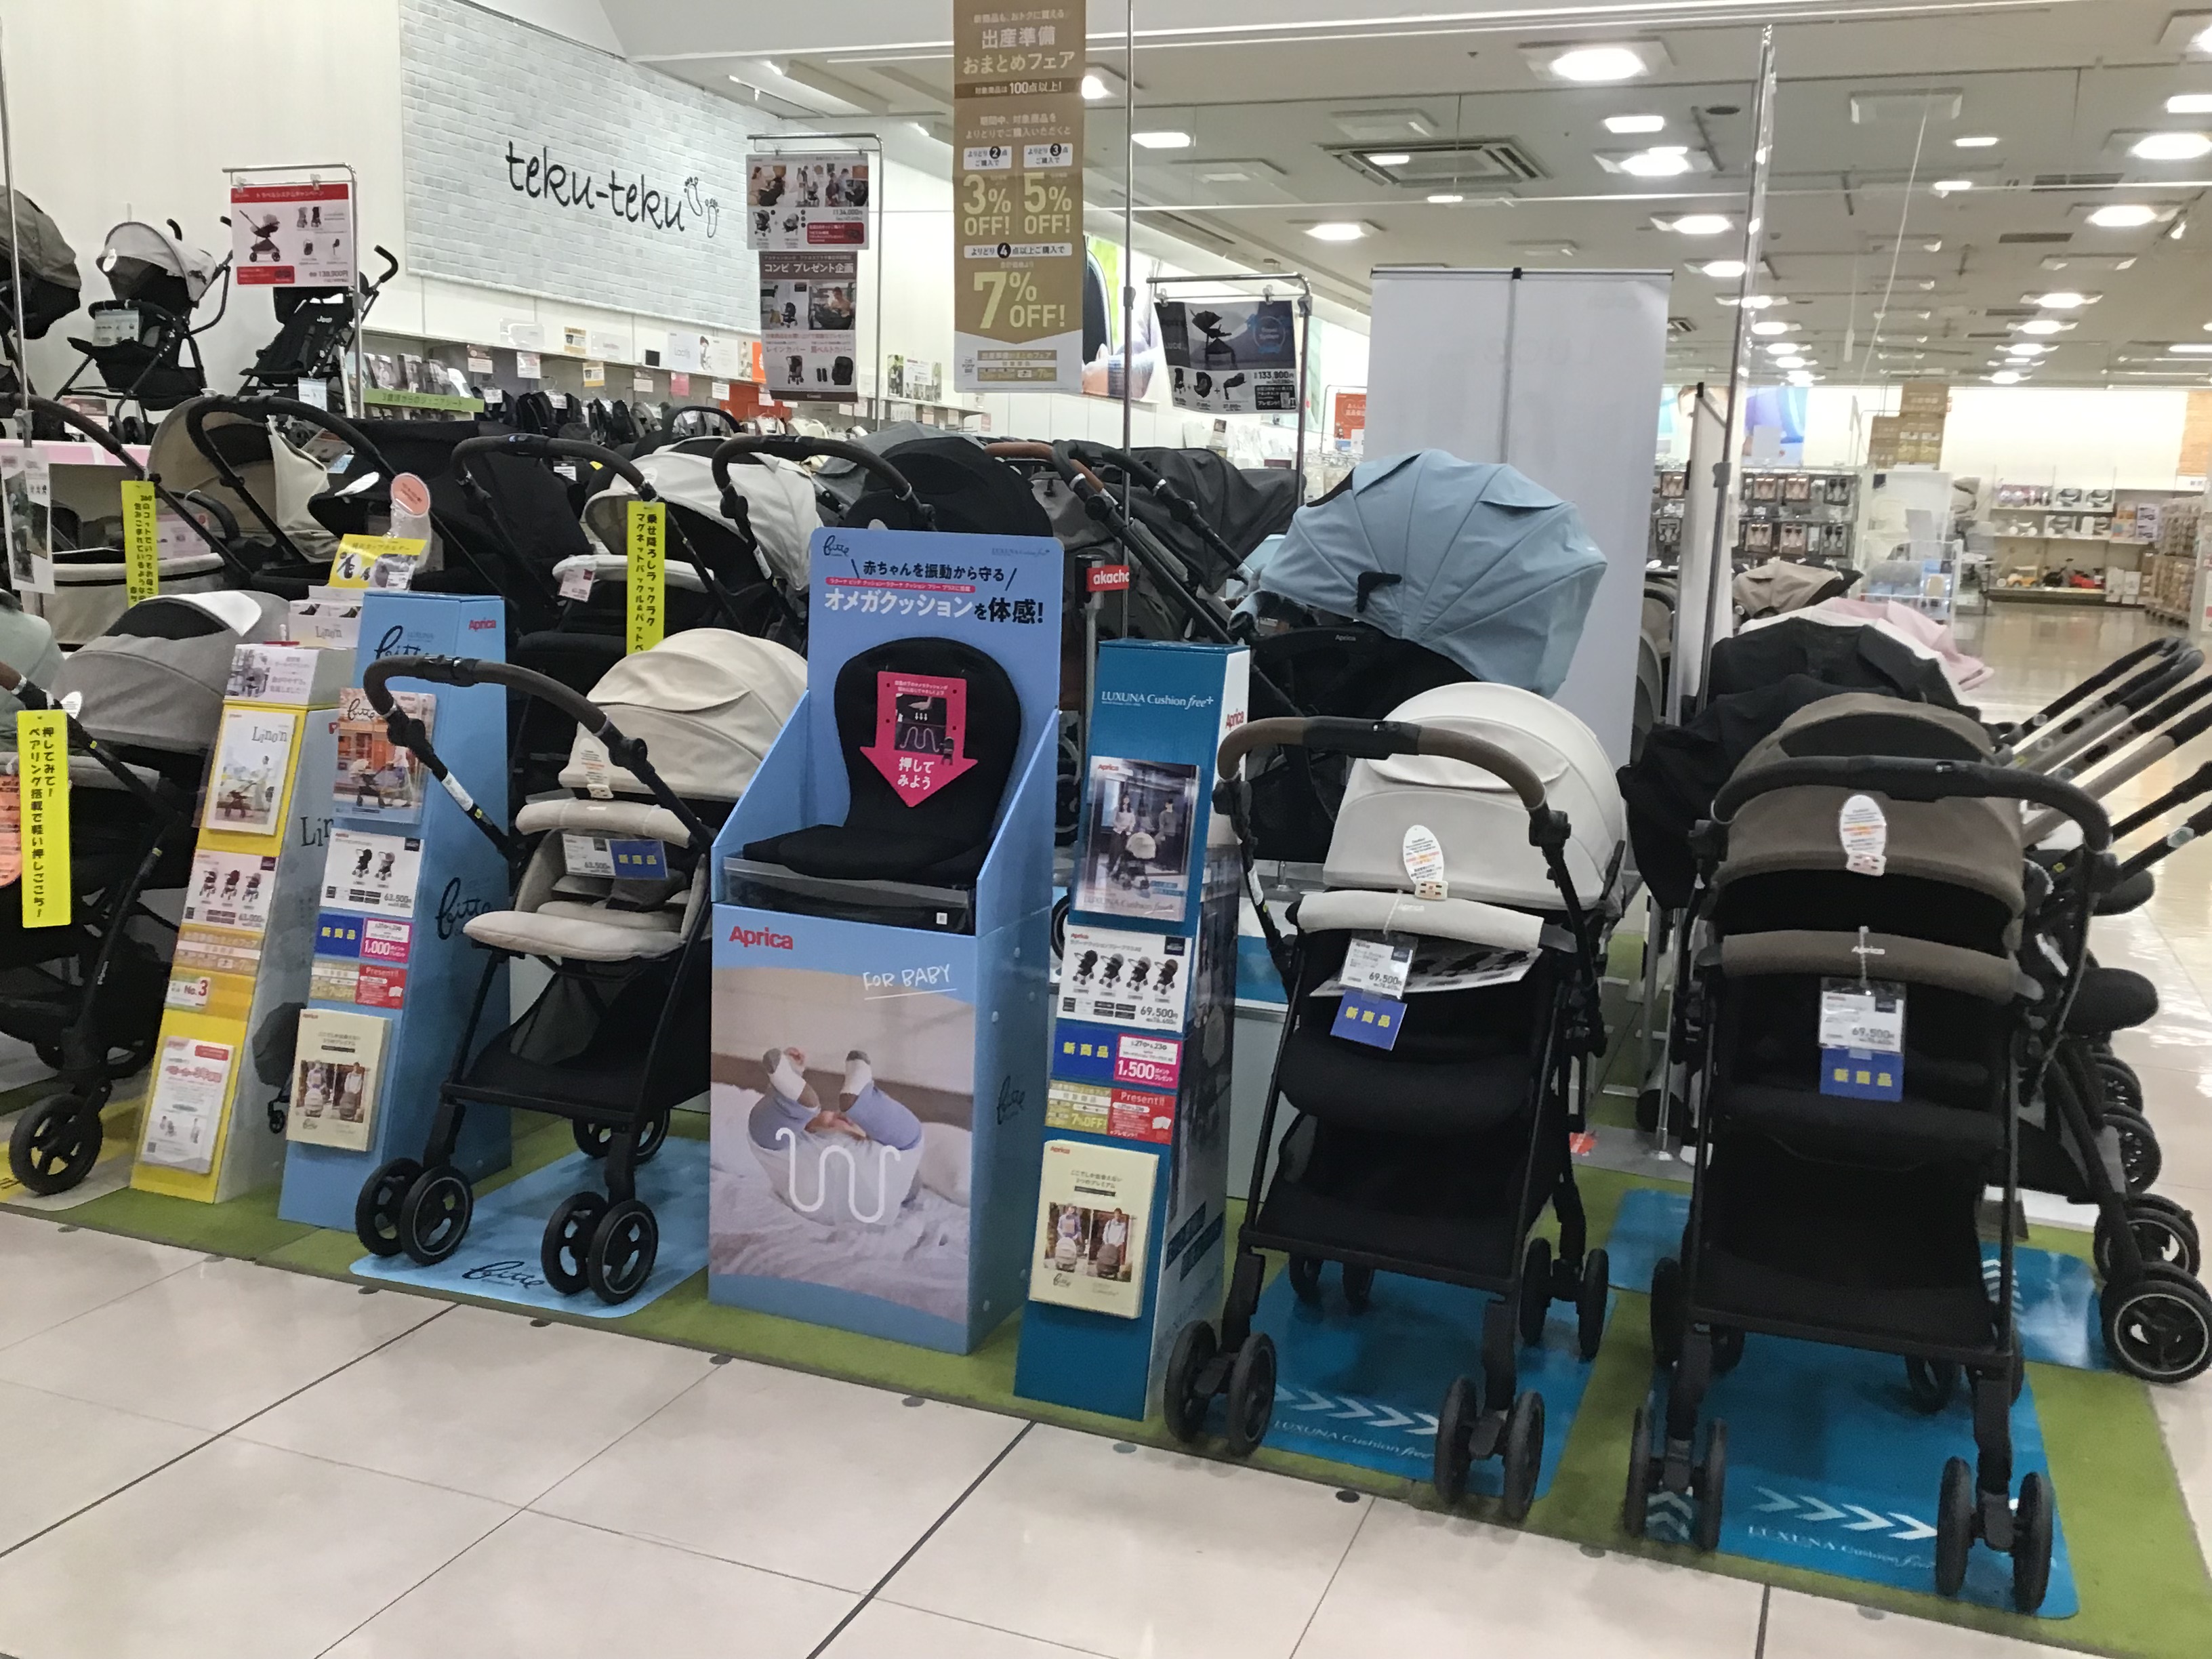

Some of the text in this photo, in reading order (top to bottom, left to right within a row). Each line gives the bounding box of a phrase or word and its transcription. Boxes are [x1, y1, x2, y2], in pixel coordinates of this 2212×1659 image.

[982, 25, 1055, 49] 出産準備
[963, 52, 1075, 75] おまとめフェア
[506, 140, 684, 232] teku-teku
[963, 174, 1011, 215] 3%
[1023, 172, 1072, 213] 5%
[964, 216, 1010, 236] OFF!
[1024, 214, 1071, 234] OFF!
[764, 263, 854, 274] コンビ プレゼント企画
[974, 272, 1037, 329] 7%
[1010, 305, 1065, 328] OFF!
[863, 560, 1004, 581] 赤ちゃんを振動から守る
[825, 588, 1044, 624] オメガクッションを体感!
[469, 617, 496, 632] Aprica
[1101, 691, 1145, 702] LUXUNA
[1147, 693, 1186, 706] Cushion
[899, 756, 934, 773] 押して
[898, 775, 931, 790] みよう
[729, 926, 794, 950] Aprica
[863, 964, 951, 991] FOR BABY
[1118, 1059, 1155, 1080] 1,500
